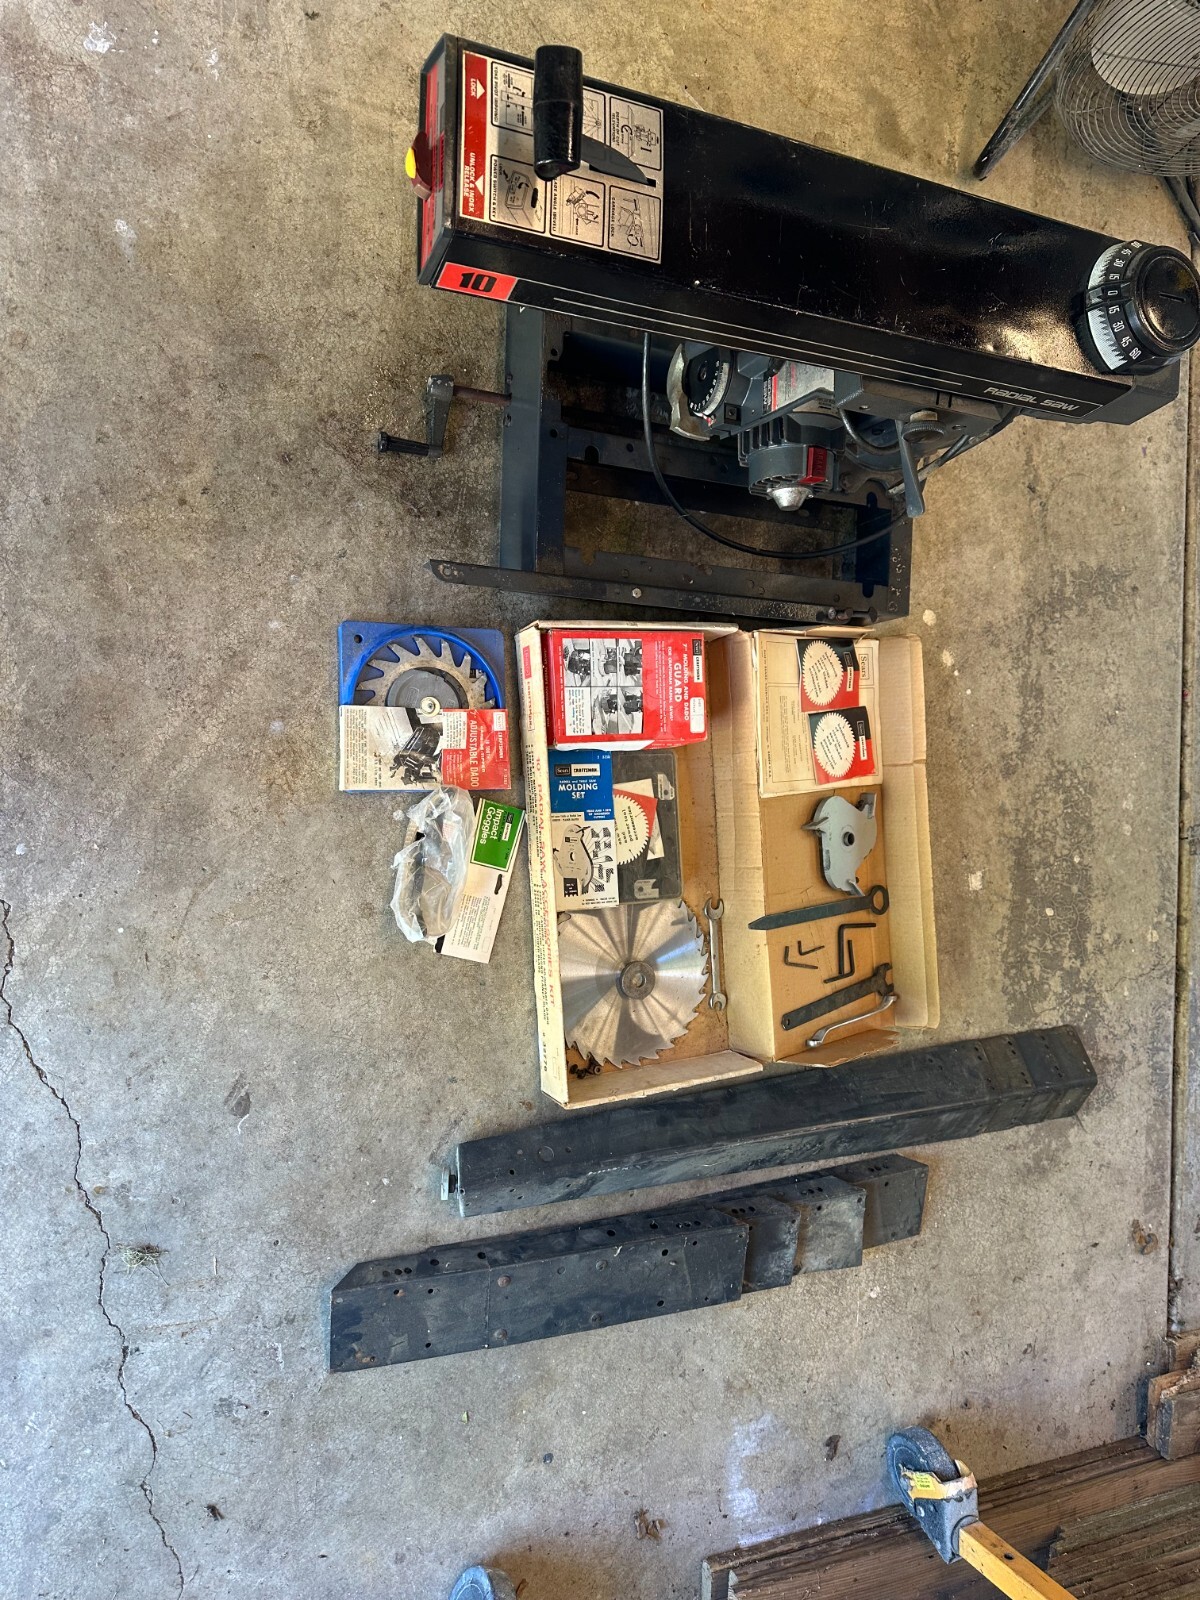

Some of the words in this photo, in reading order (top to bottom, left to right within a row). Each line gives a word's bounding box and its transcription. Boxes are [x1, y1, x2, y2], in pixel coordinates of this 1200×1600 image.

[1113, 259, 1125, 267] 30
[459, 272, 498, 292] 10
[1109, 305, 1119, 314] 15
[1113, 320, 1125, 332] 30
[1121, 336, 1132, 348] 45
[1129, 347, 1142, 360] 60
[674, 663, 682, 702] GUARD
[469, 720, 478, 765] ADJUSTABLE
[470, 767, 479, 787] DADO
[558, 783, 598, 791] MOLDING
[480, 807, 496, 844] Goggles
[490, 808, 504, 839] Impact
[625, 823, 633, 842] power
